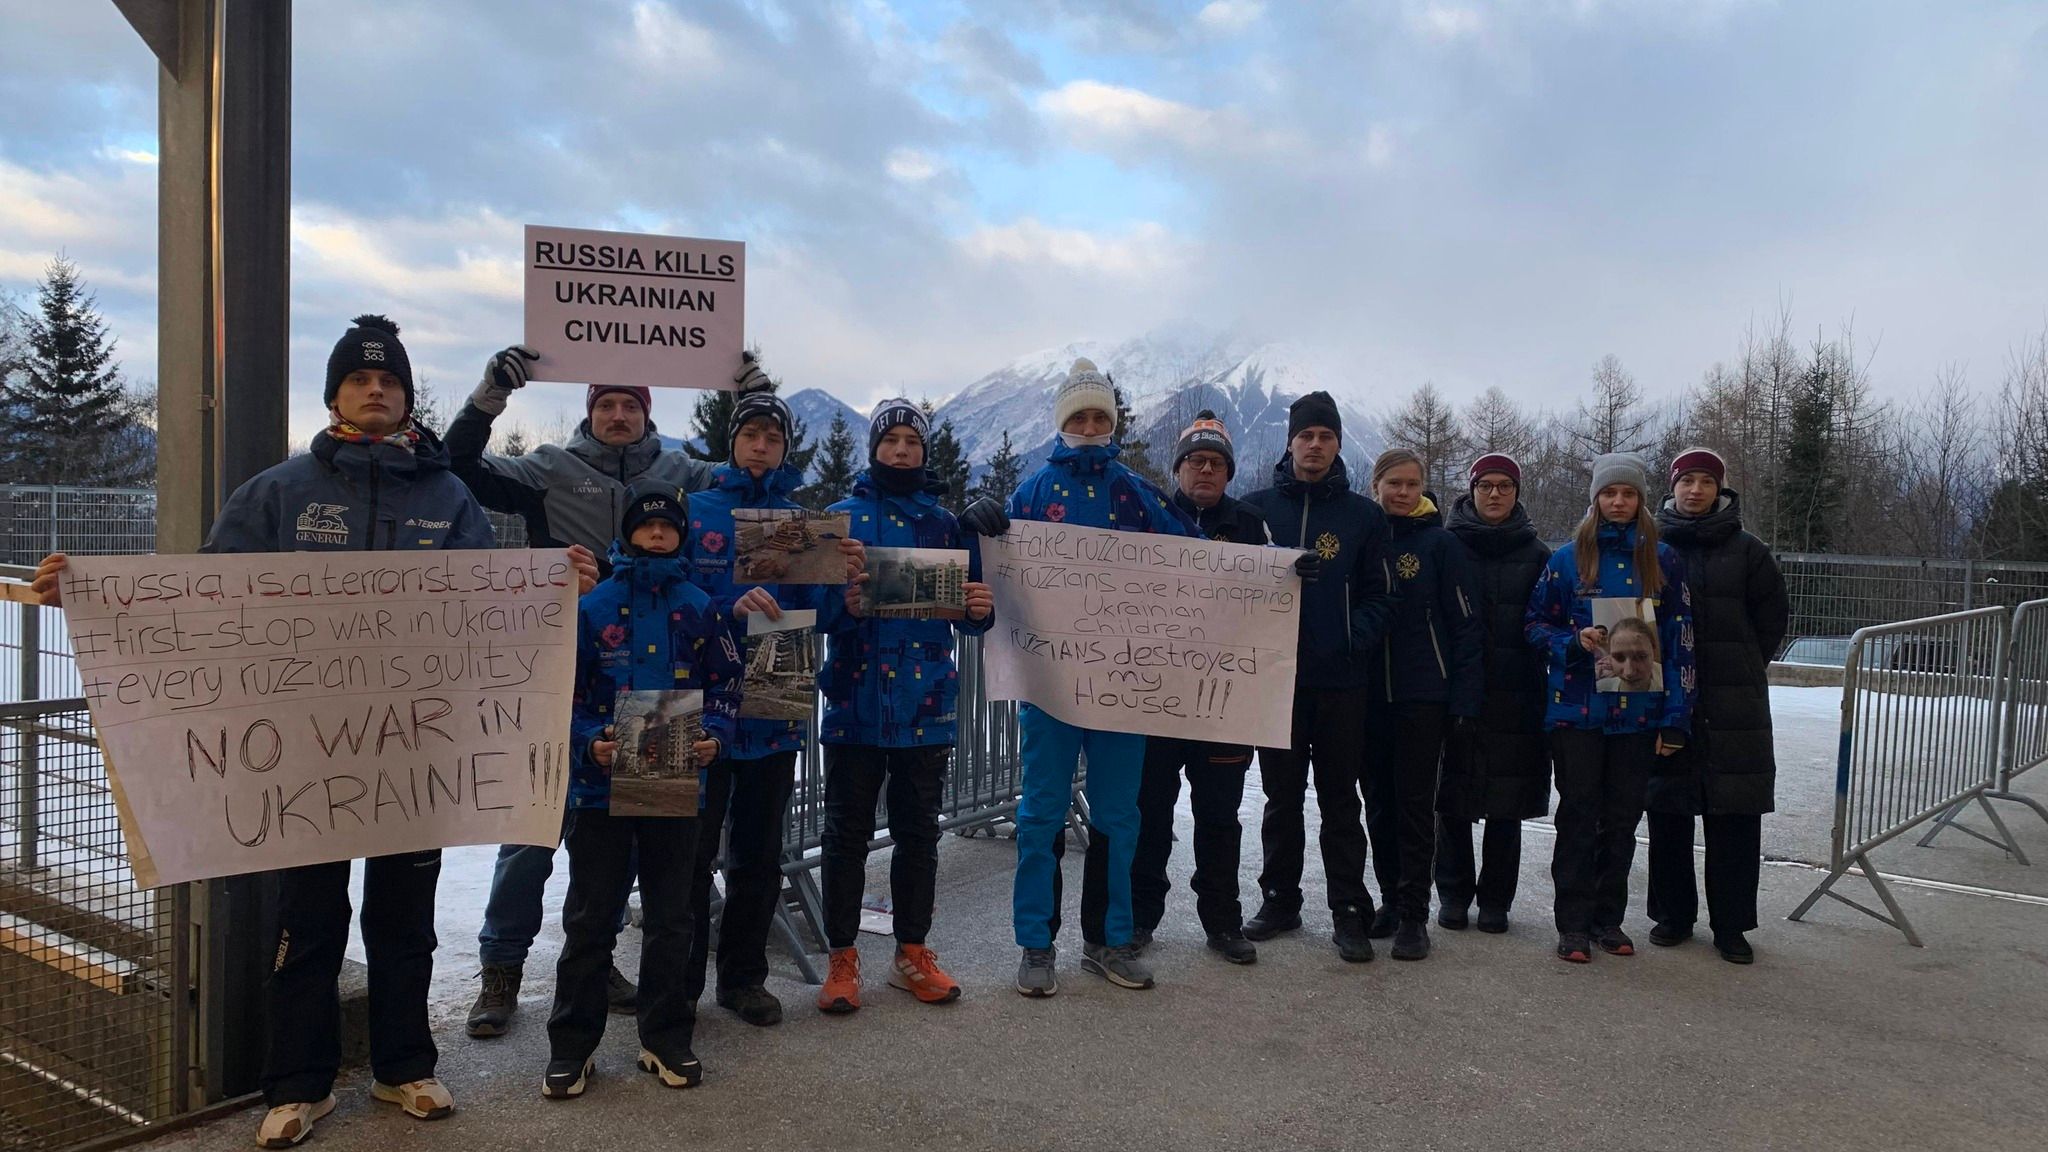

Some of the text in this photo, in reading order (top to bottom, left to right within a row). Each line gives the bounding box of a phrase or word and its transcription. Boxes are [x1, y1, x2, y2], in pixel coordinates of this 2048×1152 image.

[535, 241, 735, 277] RUSSIA KILLS
[555, 281, 715, 312] UKRAINIAN
[564, 320, 706, 348] CIVILIANS
[876, 412, 890, 432] LET
[896, 409, 906, 423] IT
[296, 531, 348, 545] GENERALI
[417, 518, 452, 529] TERREX
[1084, 595, 1206, 620] Ukrainian
[1124, 582, 1167, 598] are
[1176, 578, 1294, 615] kidnapping
[73, 600, 563, 658] #first-stop WAR in Ukraine
[1113, 638, 1257, 676] destroyed
[84, 666, 223, 710] #every
[380, 655, 411, 688] is
[417, 640, 539, 690] gulity
[1107, 670, 1162, 692] my
[186, 717, 282, 782] NO
[309, 697, 455, 758] WAR
